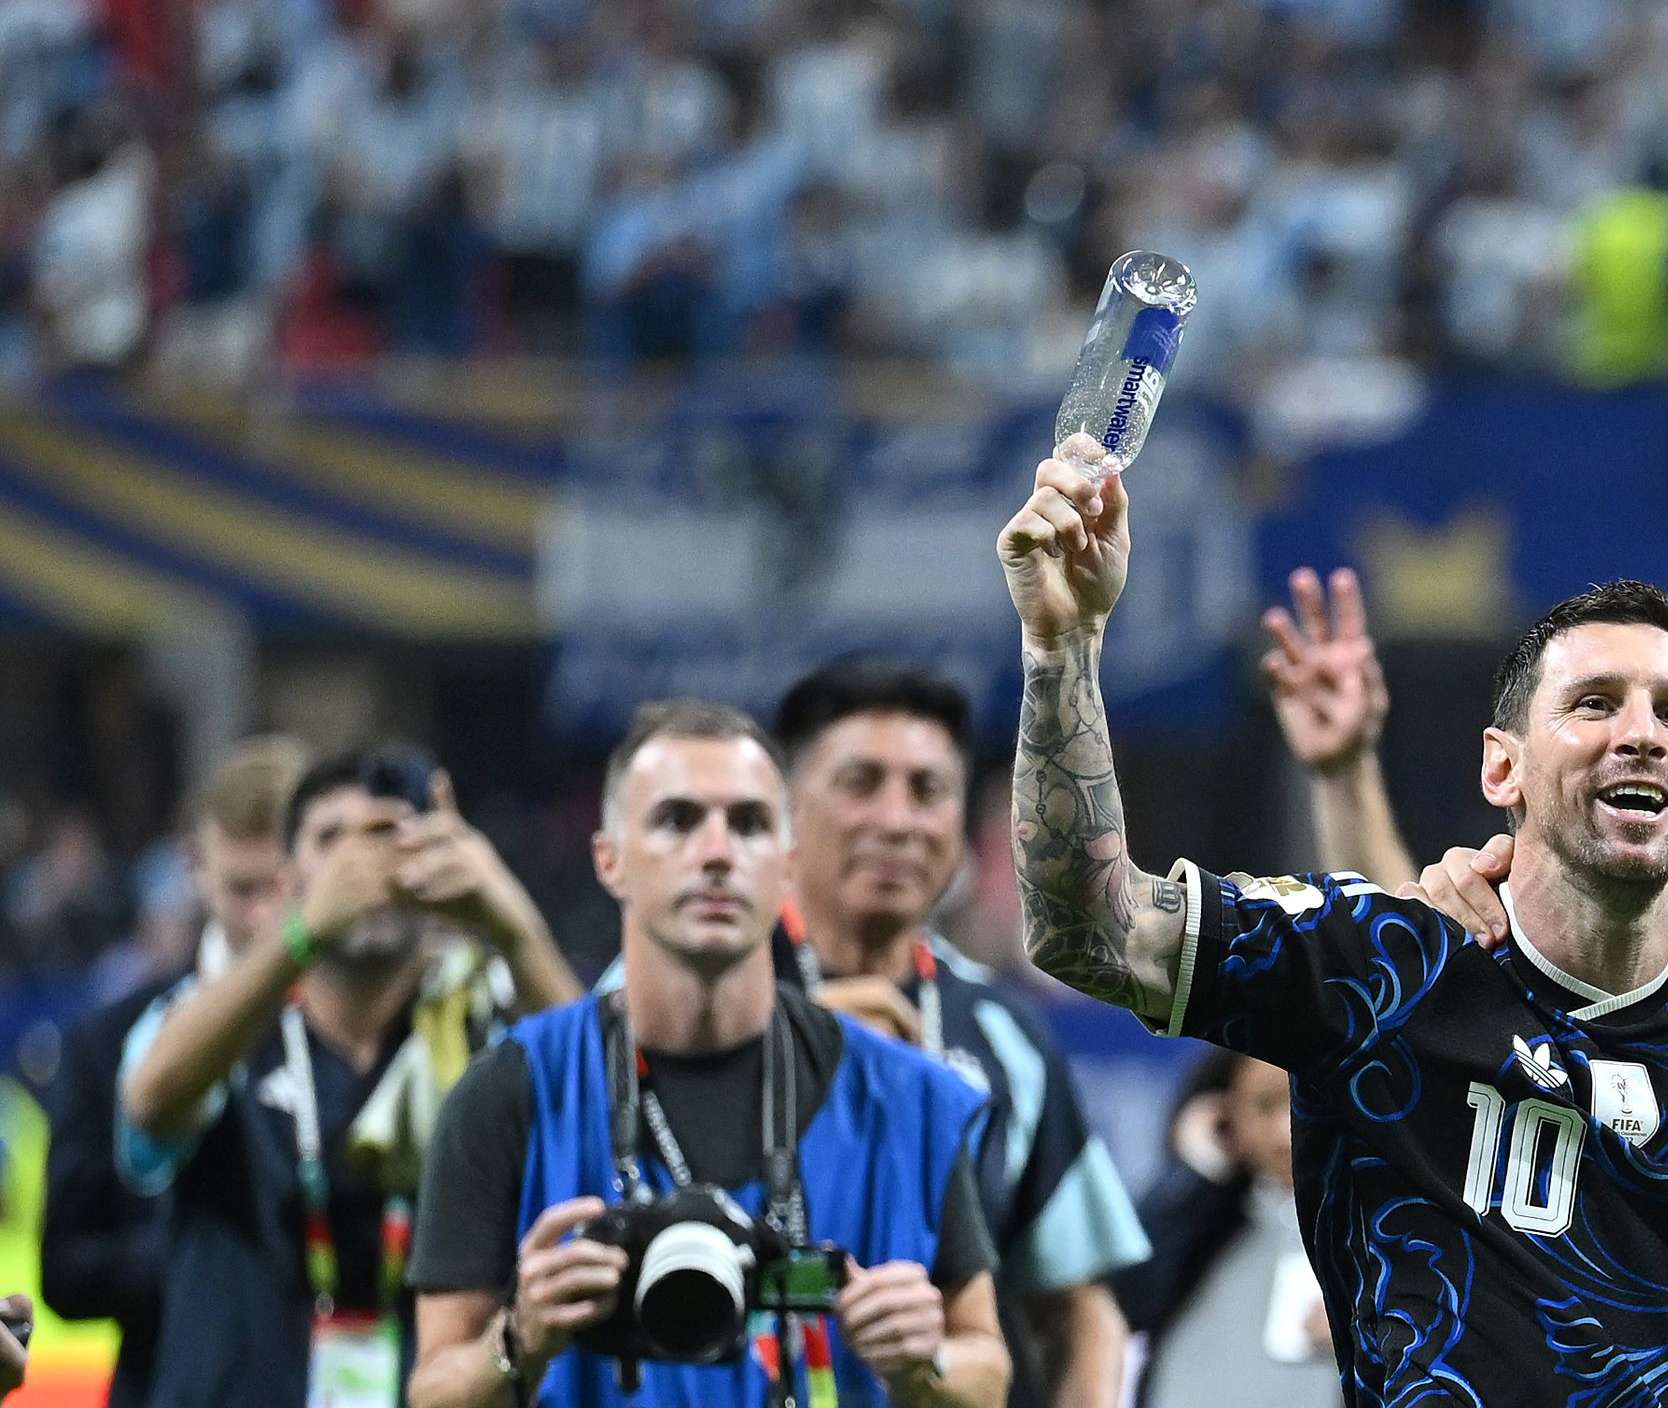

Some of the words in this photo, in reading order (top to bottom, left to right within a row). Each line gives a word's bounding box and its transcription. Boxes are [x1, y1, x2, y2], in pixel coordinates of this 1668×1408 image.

[1102, 356, 1149, 452] smartwater
[1463, 1081, 1588, 1238] 10
[1612, 1119, 1641, 1131] FIFA
